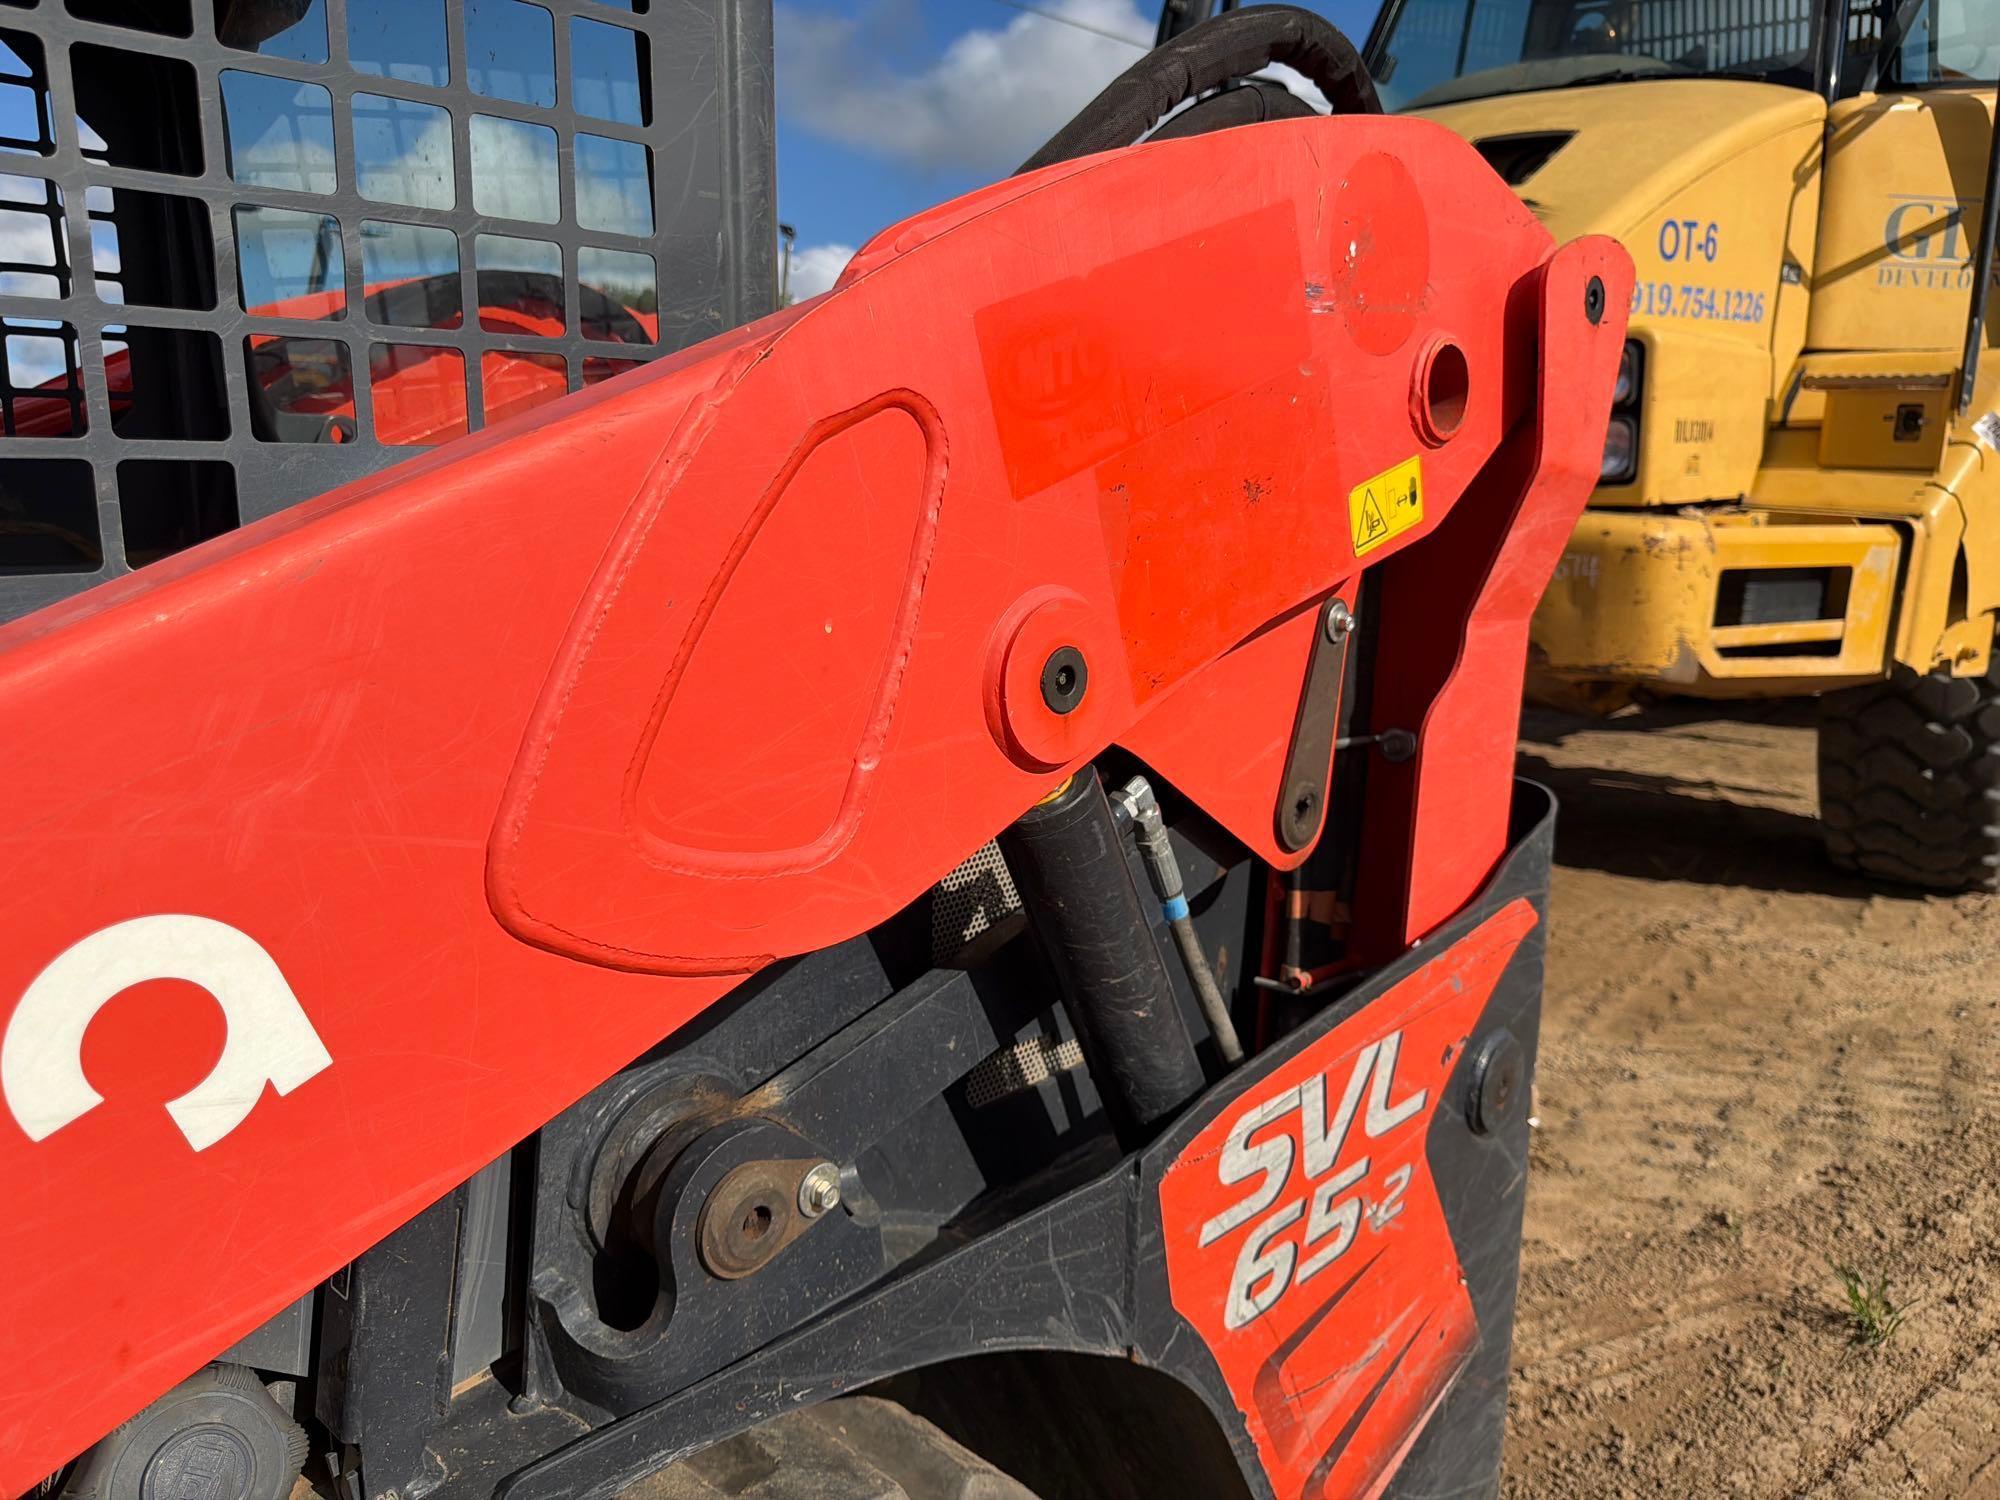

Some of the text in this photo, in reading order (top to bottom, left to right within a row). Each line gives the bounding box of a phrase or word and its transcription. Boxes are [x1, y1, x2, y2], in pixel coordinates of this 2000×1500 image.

[1658, 218, 1718, 262] OT-6
[1877, 268, 1973, 289] DEVELO
[1197, 1029, 1429, 1249] SVL
